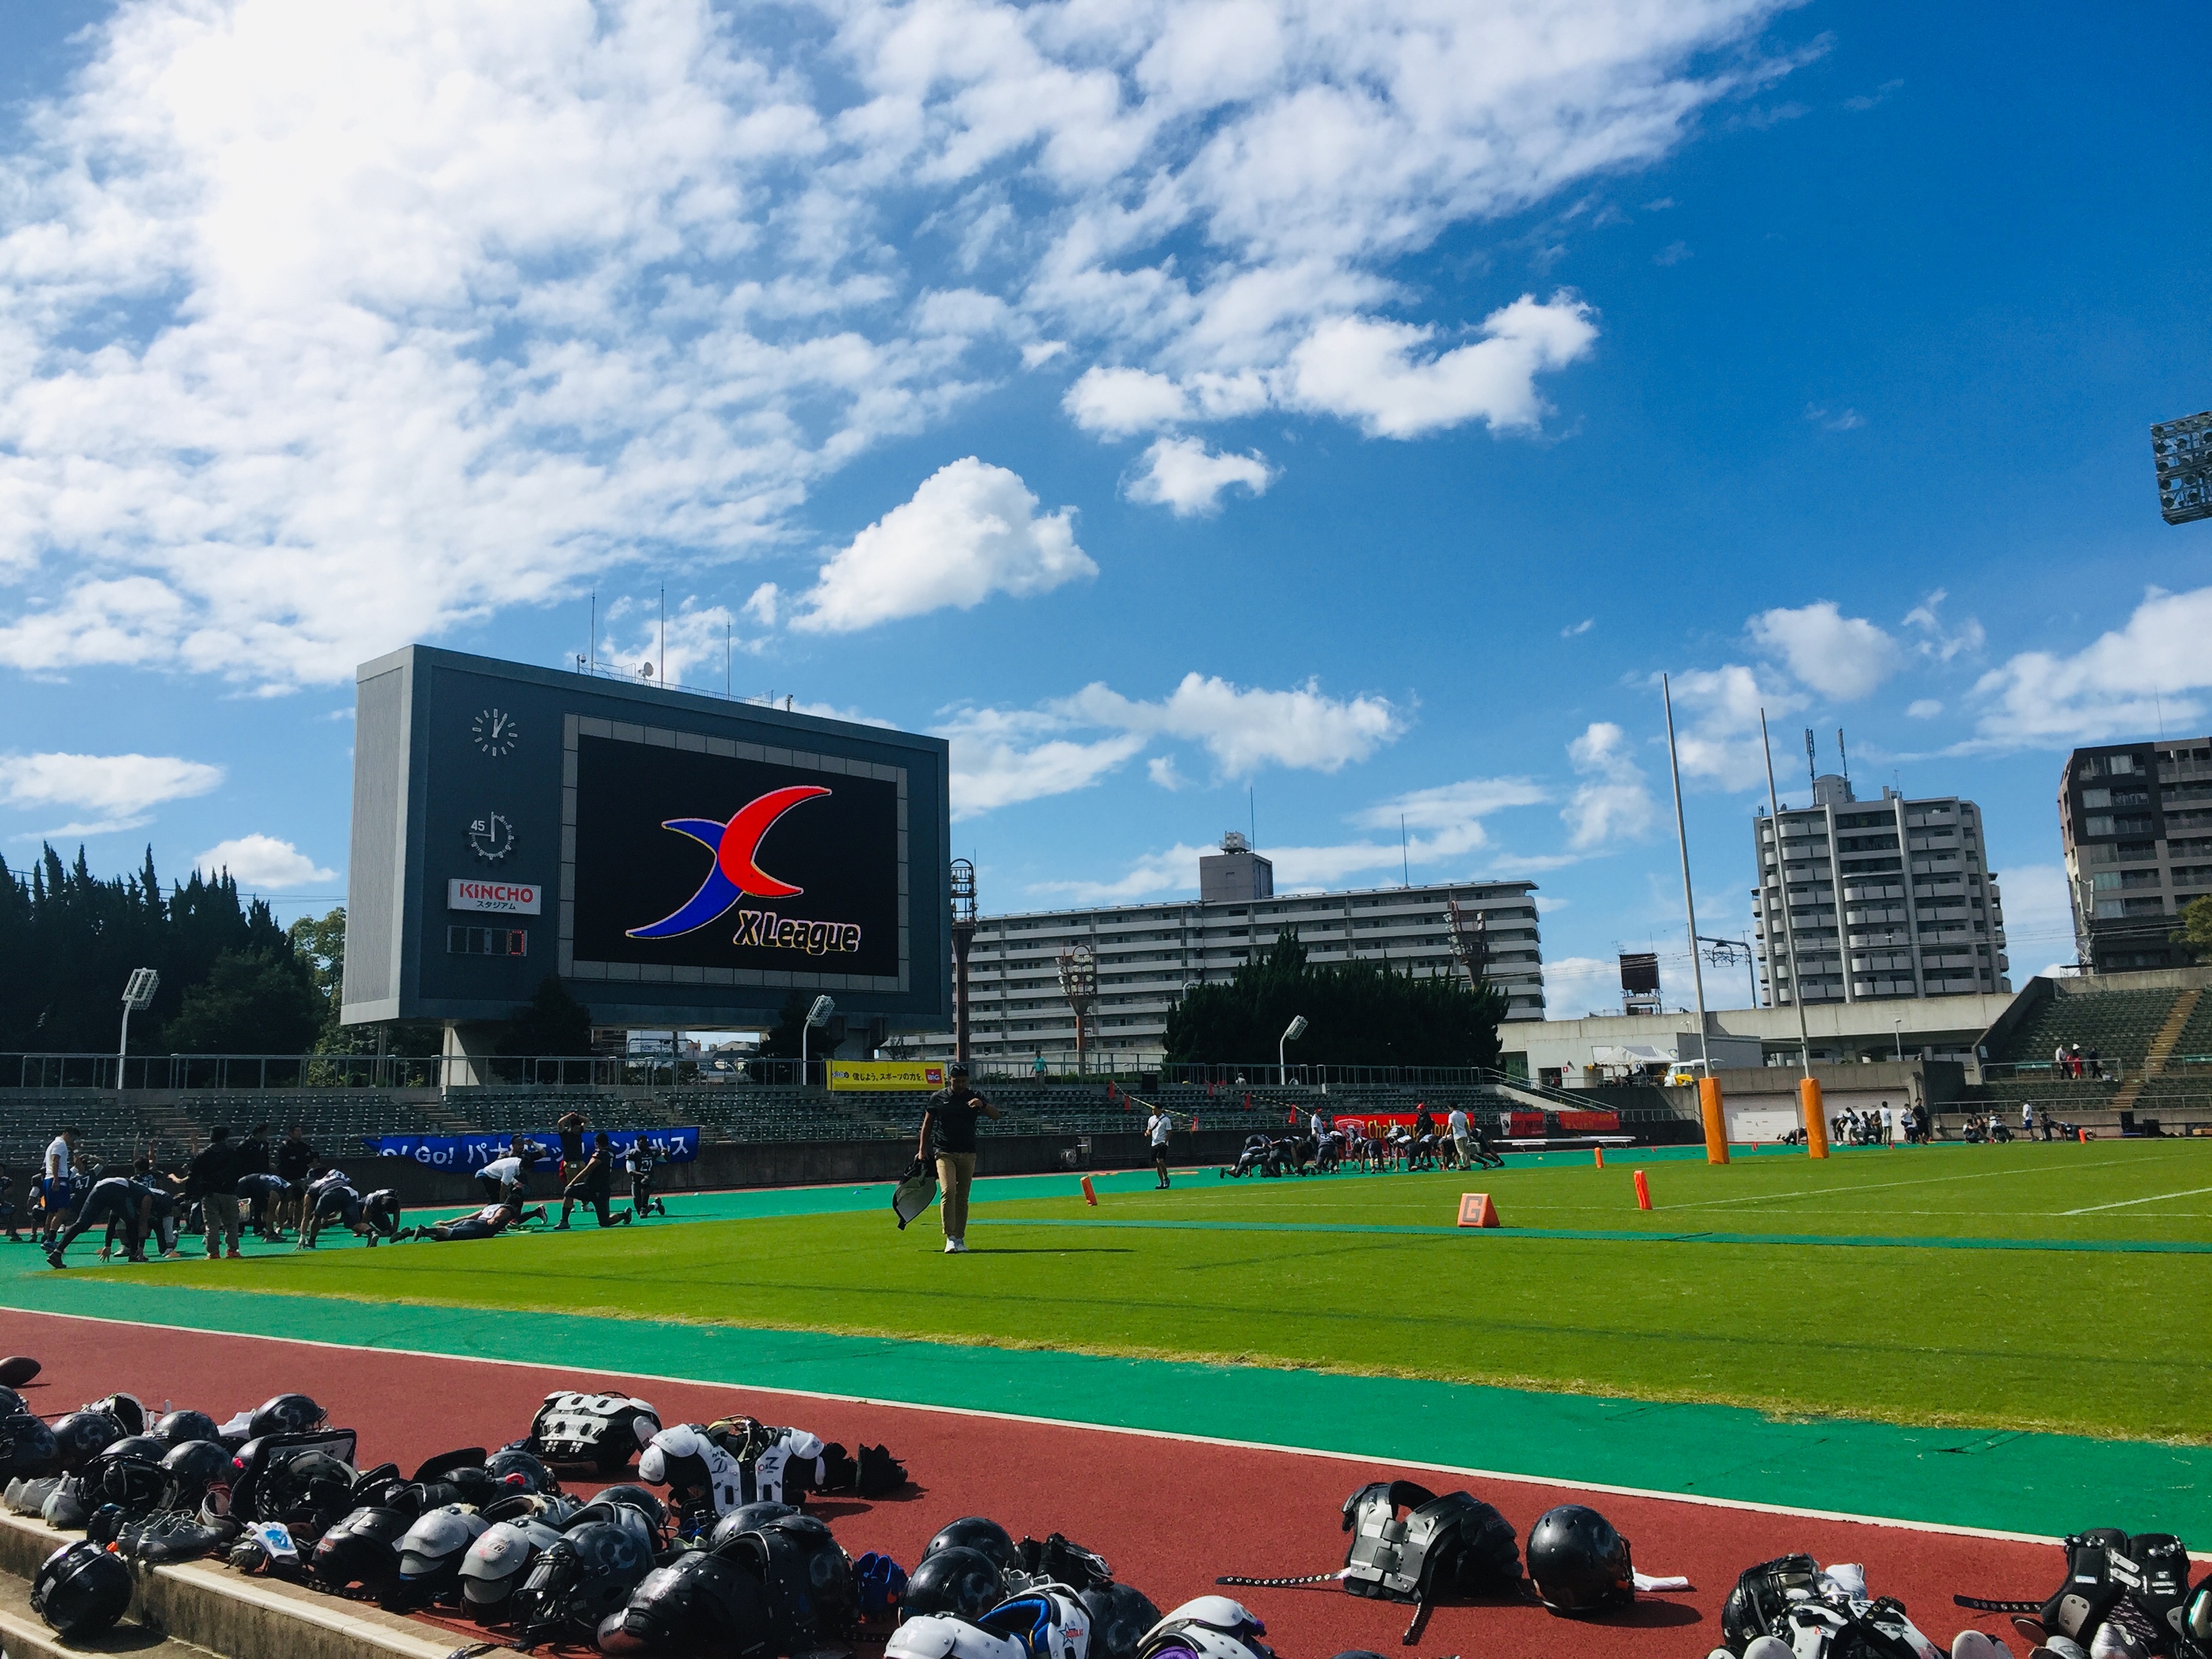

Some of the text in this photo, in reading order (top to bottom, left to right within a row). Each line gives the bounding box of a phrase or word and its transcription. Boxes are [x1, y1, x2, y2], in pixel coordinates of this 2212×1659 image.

[471, 820, 485, 832] 45
[459, 883, 533, 903] KINCHO
[477, 901, 516, 909] スタジアム
[733, 909, 861, 956] X League
[415, 1146, 453, 1164] Go!
[640, 1160, 653, 1171] 21
[75, 1176, 90, 1189] 47
[1462, 1196, 1483, 1222] G
